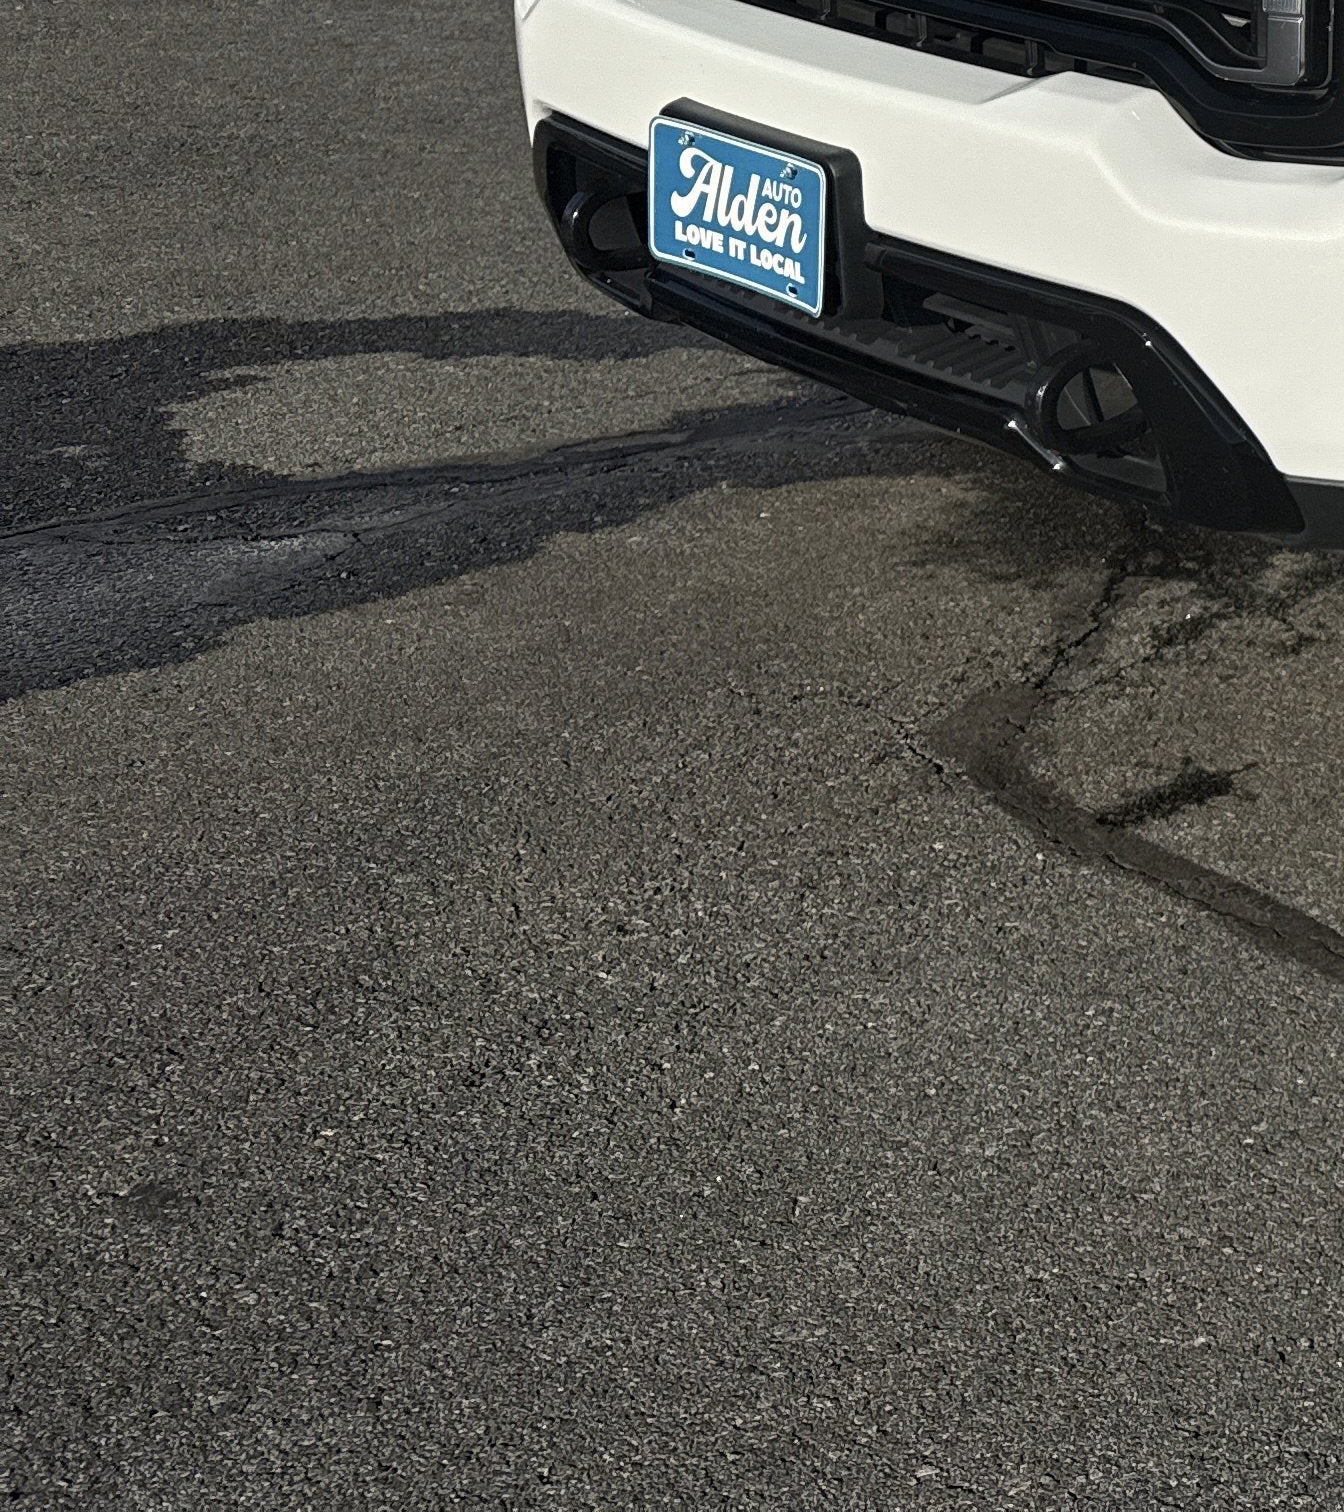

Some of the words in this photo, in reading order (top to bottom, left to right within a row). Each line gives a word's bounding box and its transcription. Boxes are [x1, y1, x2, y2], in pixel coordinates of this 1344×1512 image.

[670, 145, 808, 254] Alden
[761, 178, 803, 209] AUTO
[674, 220, 725, 254] LOVE
[728, 237, 747, 262] IT
[748, 244, 806, 285] LOCAL
